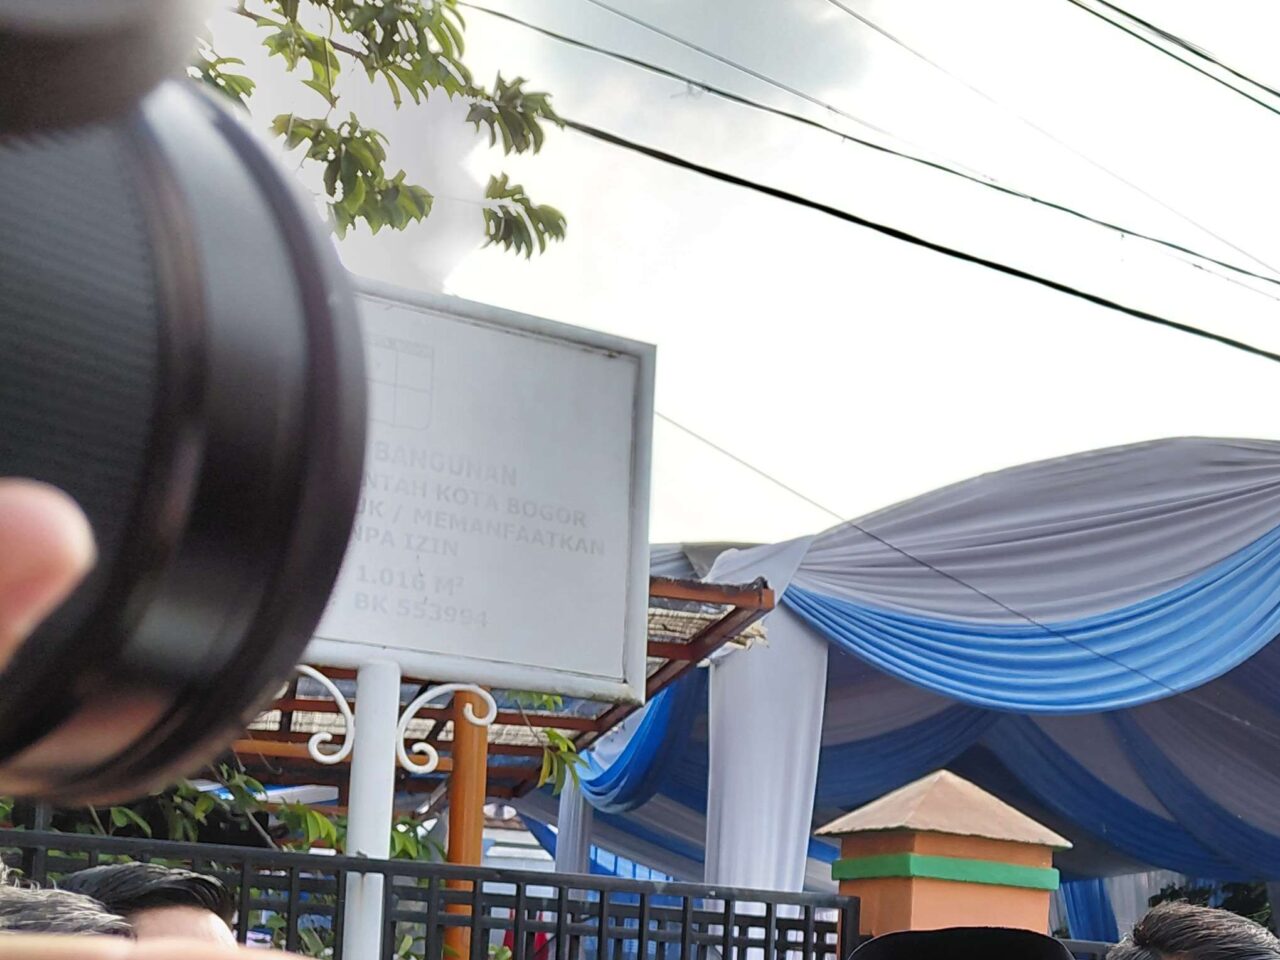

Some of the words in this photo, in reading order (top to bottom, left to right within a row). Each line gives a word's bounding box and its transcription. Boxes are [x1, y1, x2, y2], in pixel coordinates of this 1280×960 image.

[374, 441, 517, 486] BANGUNAN
[366, 471, 427, 499] NTAH
[436, 484, 499, 512] KOTA
[507, 497, 588, 528] BOGOR
[404, 534, 458, 556] IZIN
[412, 508, 606, 556] MEMANFAATKAN
[354, 592, 388, 615] BK
